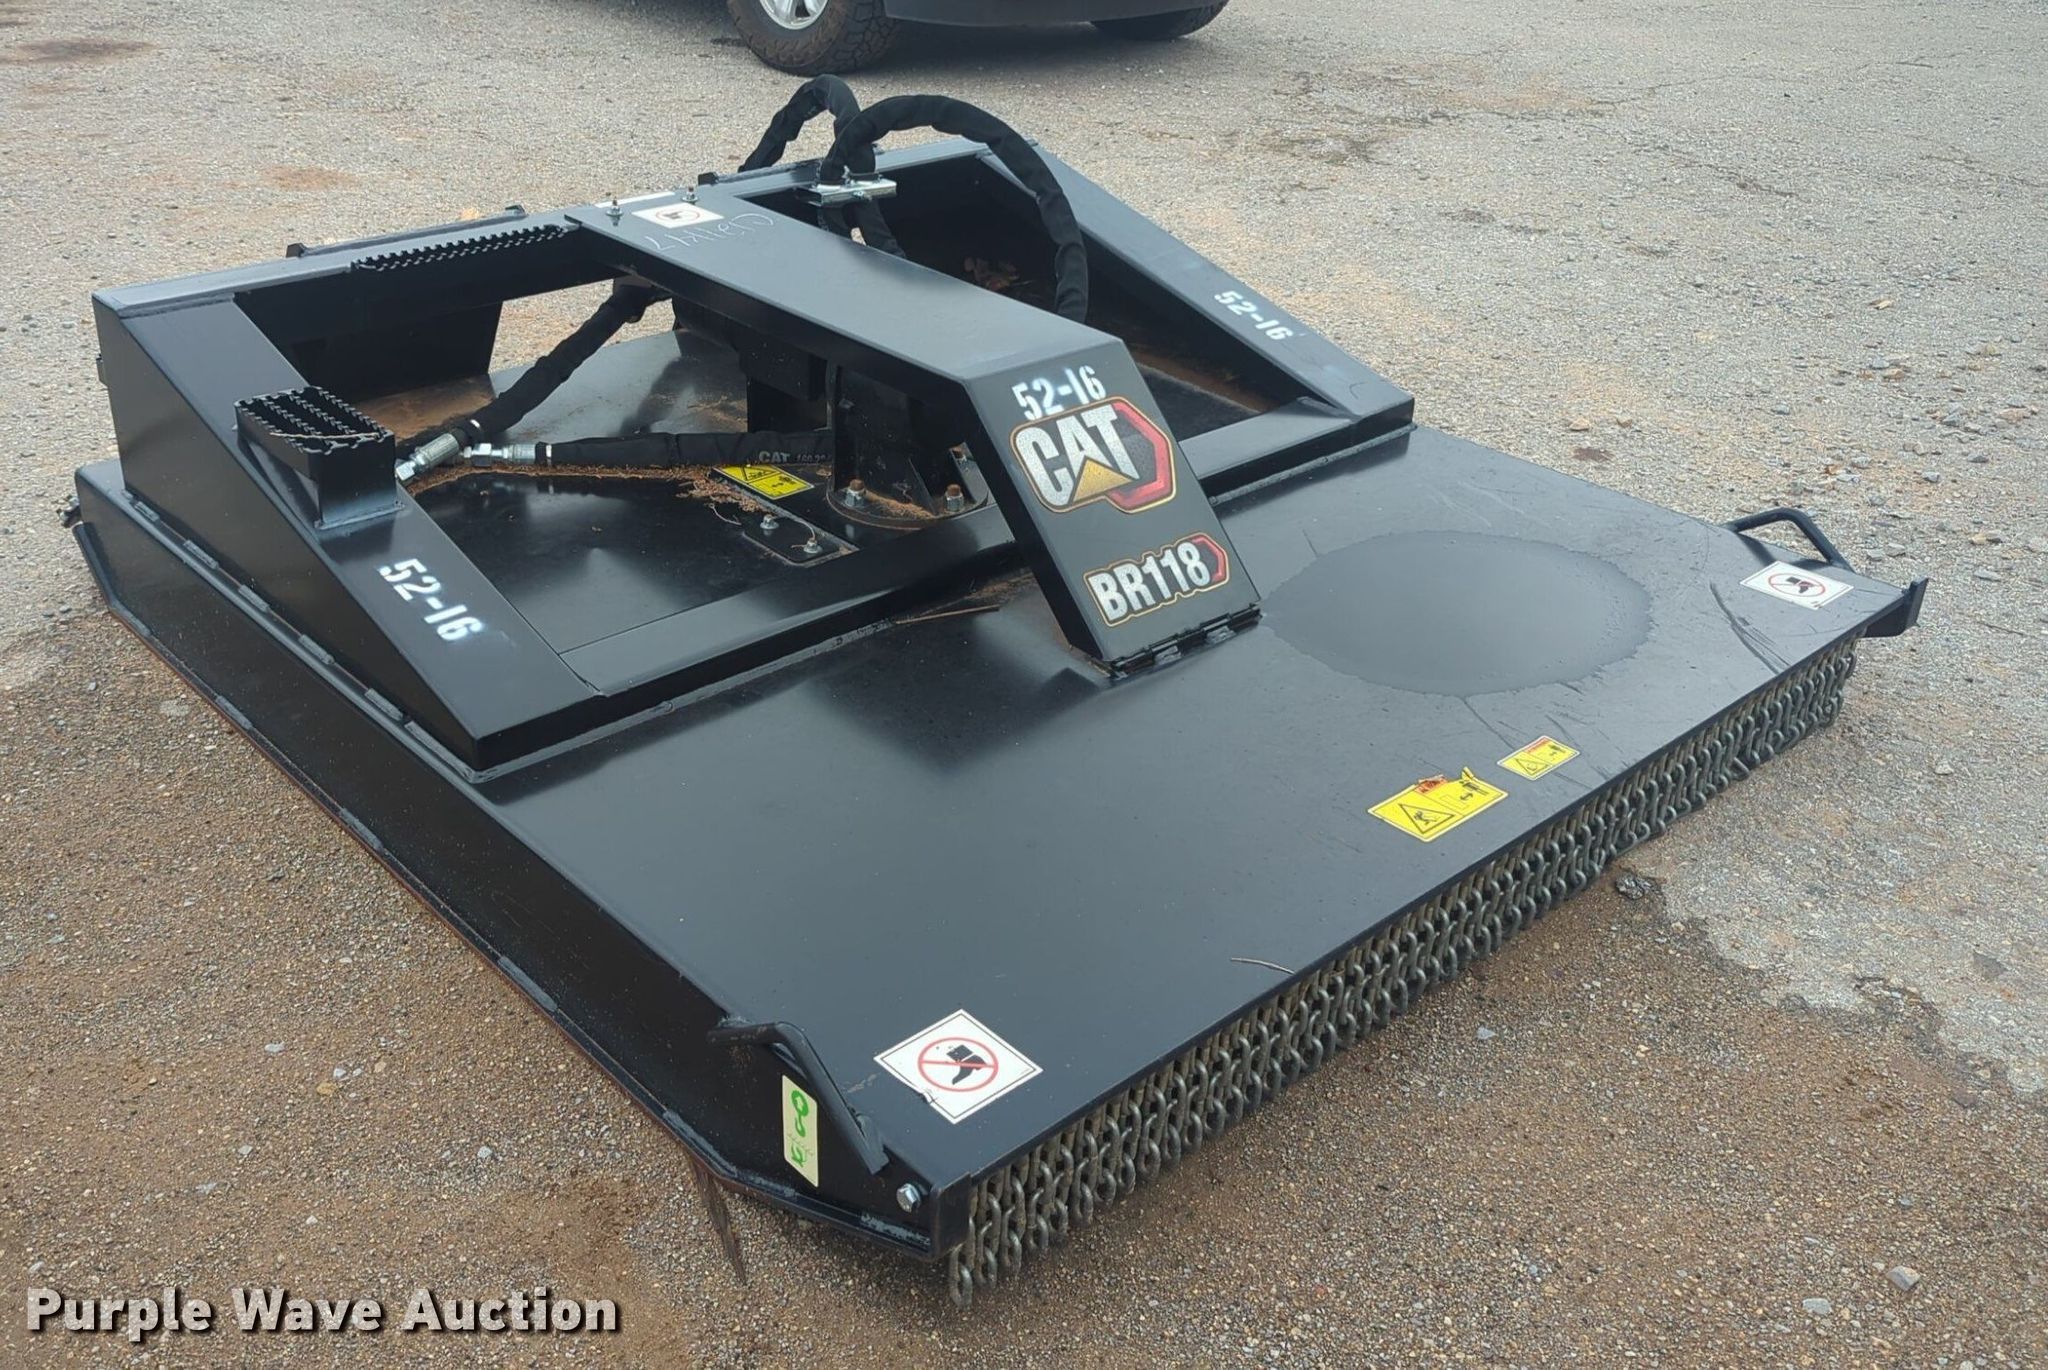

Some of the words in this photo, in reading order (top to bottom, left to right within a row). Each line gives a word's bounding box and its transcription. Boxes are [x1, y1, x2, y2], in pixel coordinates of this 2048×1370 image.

[1213, 290, 1294, 340] 52-16
[1011, 365, 1107, 421] 52-16
[758, 450, 791, 463] CAT
[1015, 403, 1141, 507] CAT
[378, 558, 485, 641] 52-16
[1087, 541, 1211, 622] BR118
